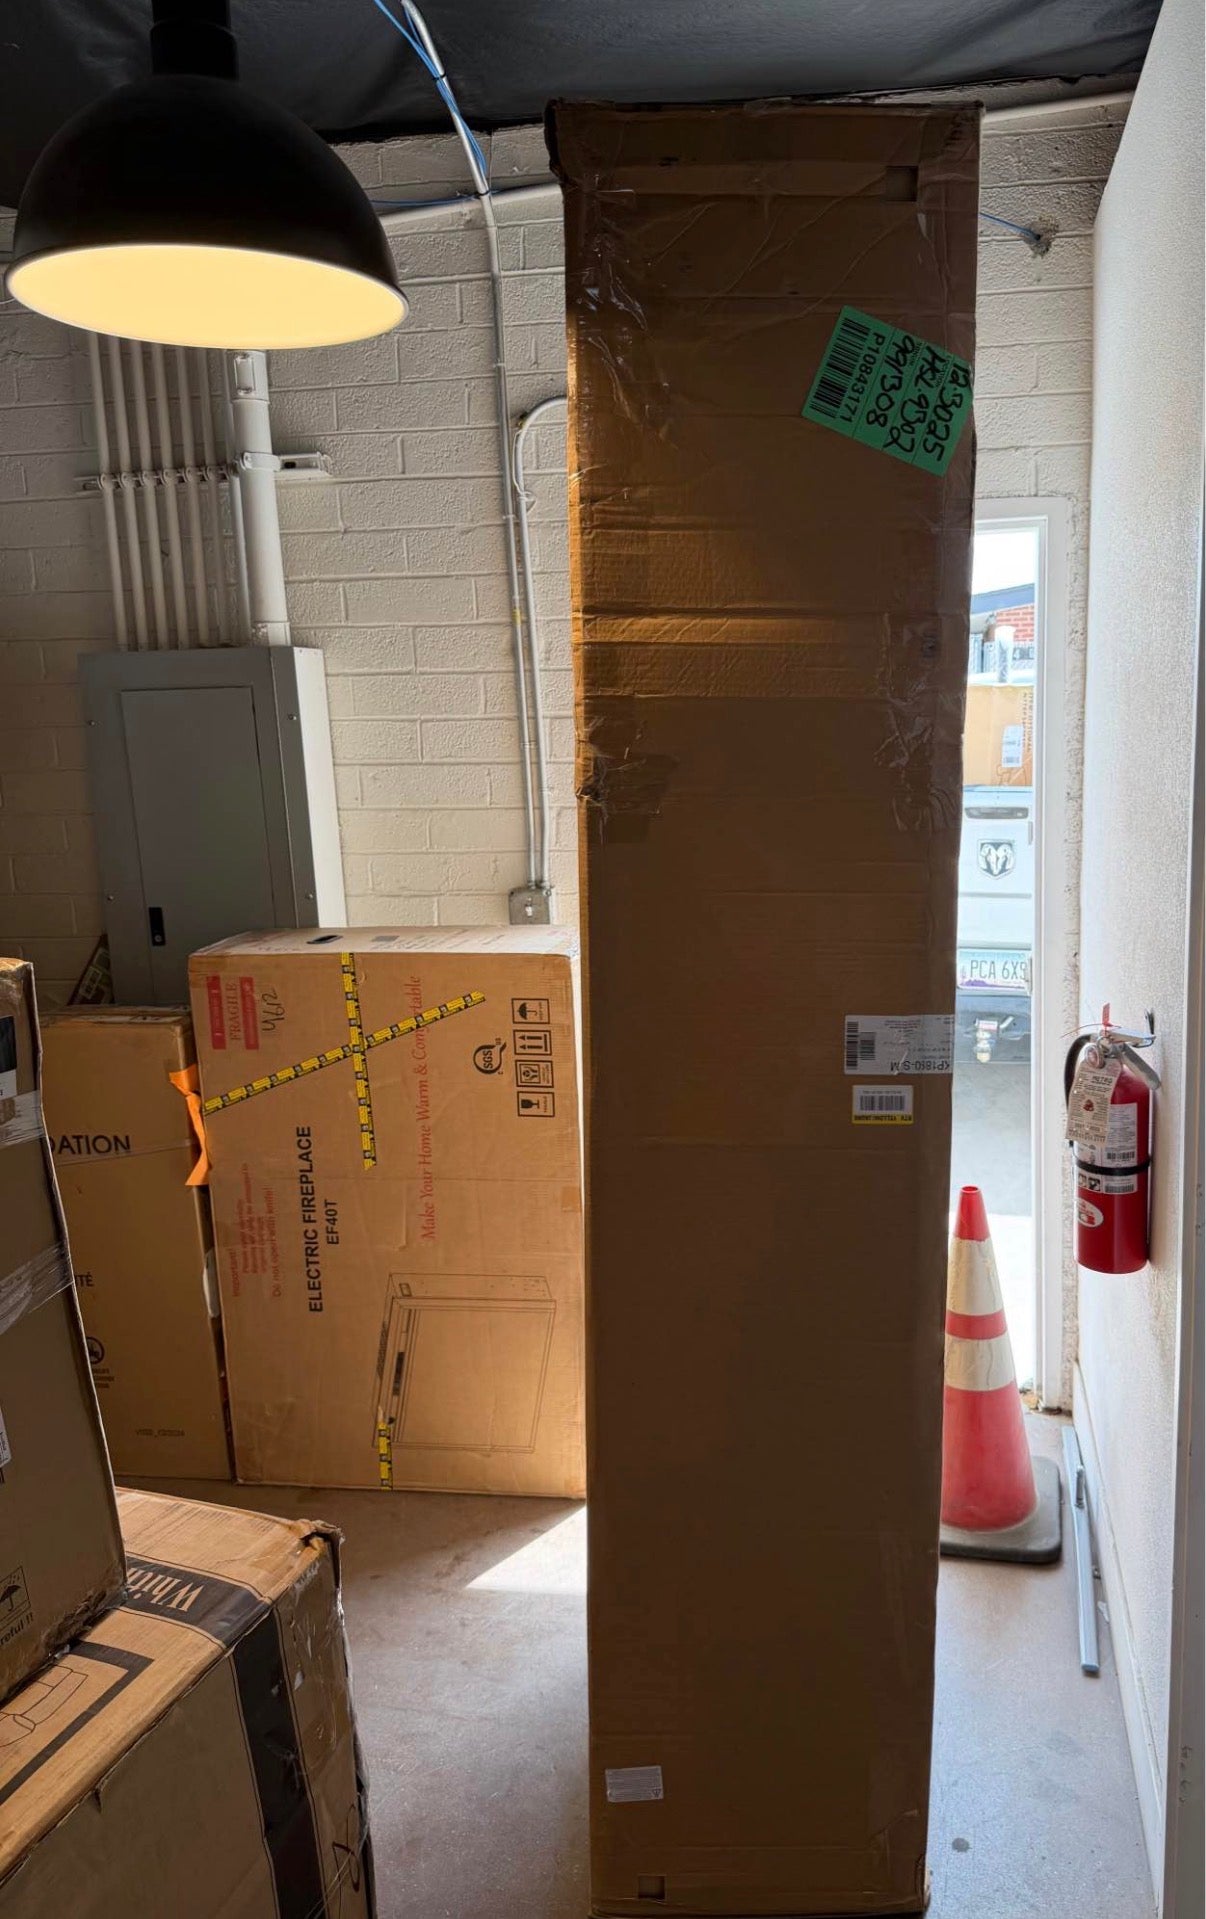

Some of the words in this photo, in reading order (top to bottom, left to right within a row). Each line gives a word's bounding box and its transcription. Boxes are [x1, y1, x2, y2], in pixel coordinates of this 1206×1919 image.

[840, 332, 885, 422] P10843171
[970, 959, 996, 980] PCA
[226, 982, 241, 1041] FRAGILE
[404, 976, 430, 1060] Comrtable
[414, 1062, 428, 1075] &
[483, 1050, 493, 1069] SGS
[416, 1082, 429, 1122] Warm
[418, 1125, 433, 1166] Home
[296, 1126, 318, 1223] FIREPLACE
[420, 1170, 435, 1202] Your
[324, 1199, 339, 1245] EF40T
[418, 1203, 435, 1239] Make
[304, 1228, 323, 1312] ELECTRIC
